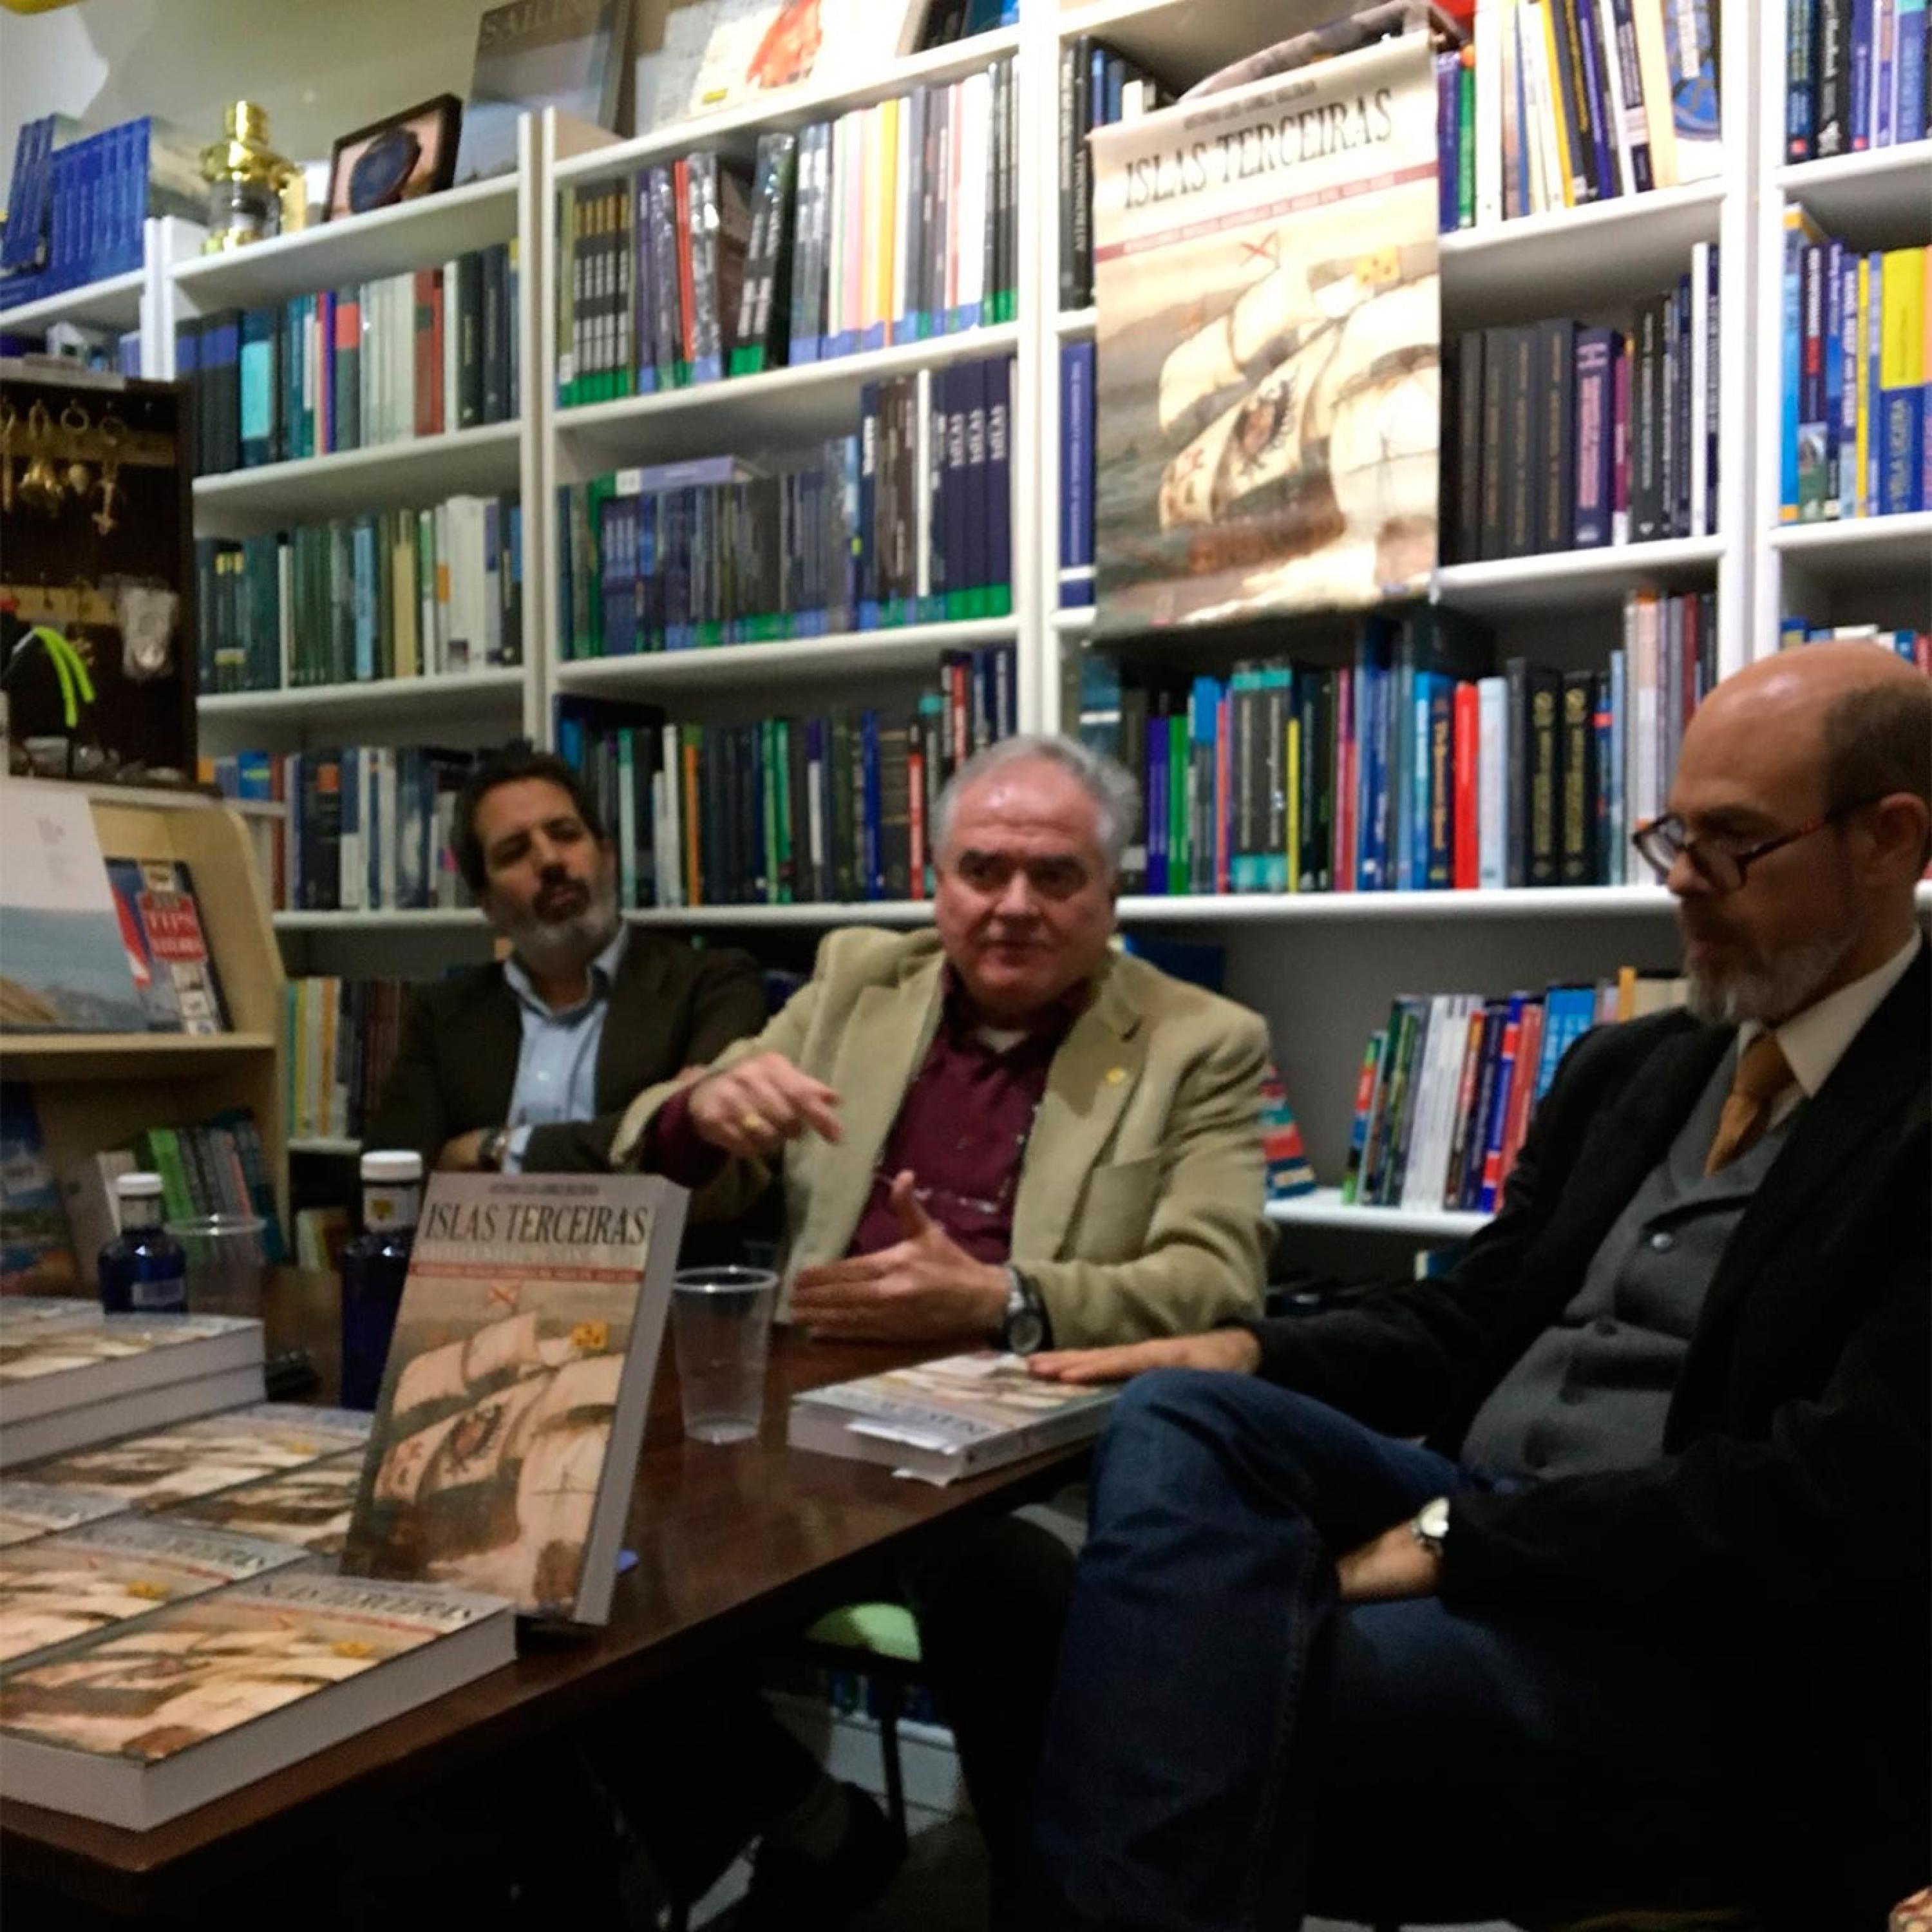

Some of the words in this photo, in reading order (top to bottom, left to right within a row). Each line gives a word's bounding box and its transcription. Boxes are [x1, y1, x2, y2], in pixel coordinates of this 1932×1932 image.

[1124, 140, 1208, 210] ISLAS
[1216, 86, 1393, 184] TERCEIRAS
[424, 1201, 500, 1243] ISLAS
[504, 1202, 649, 1245] TERCEIRAS
